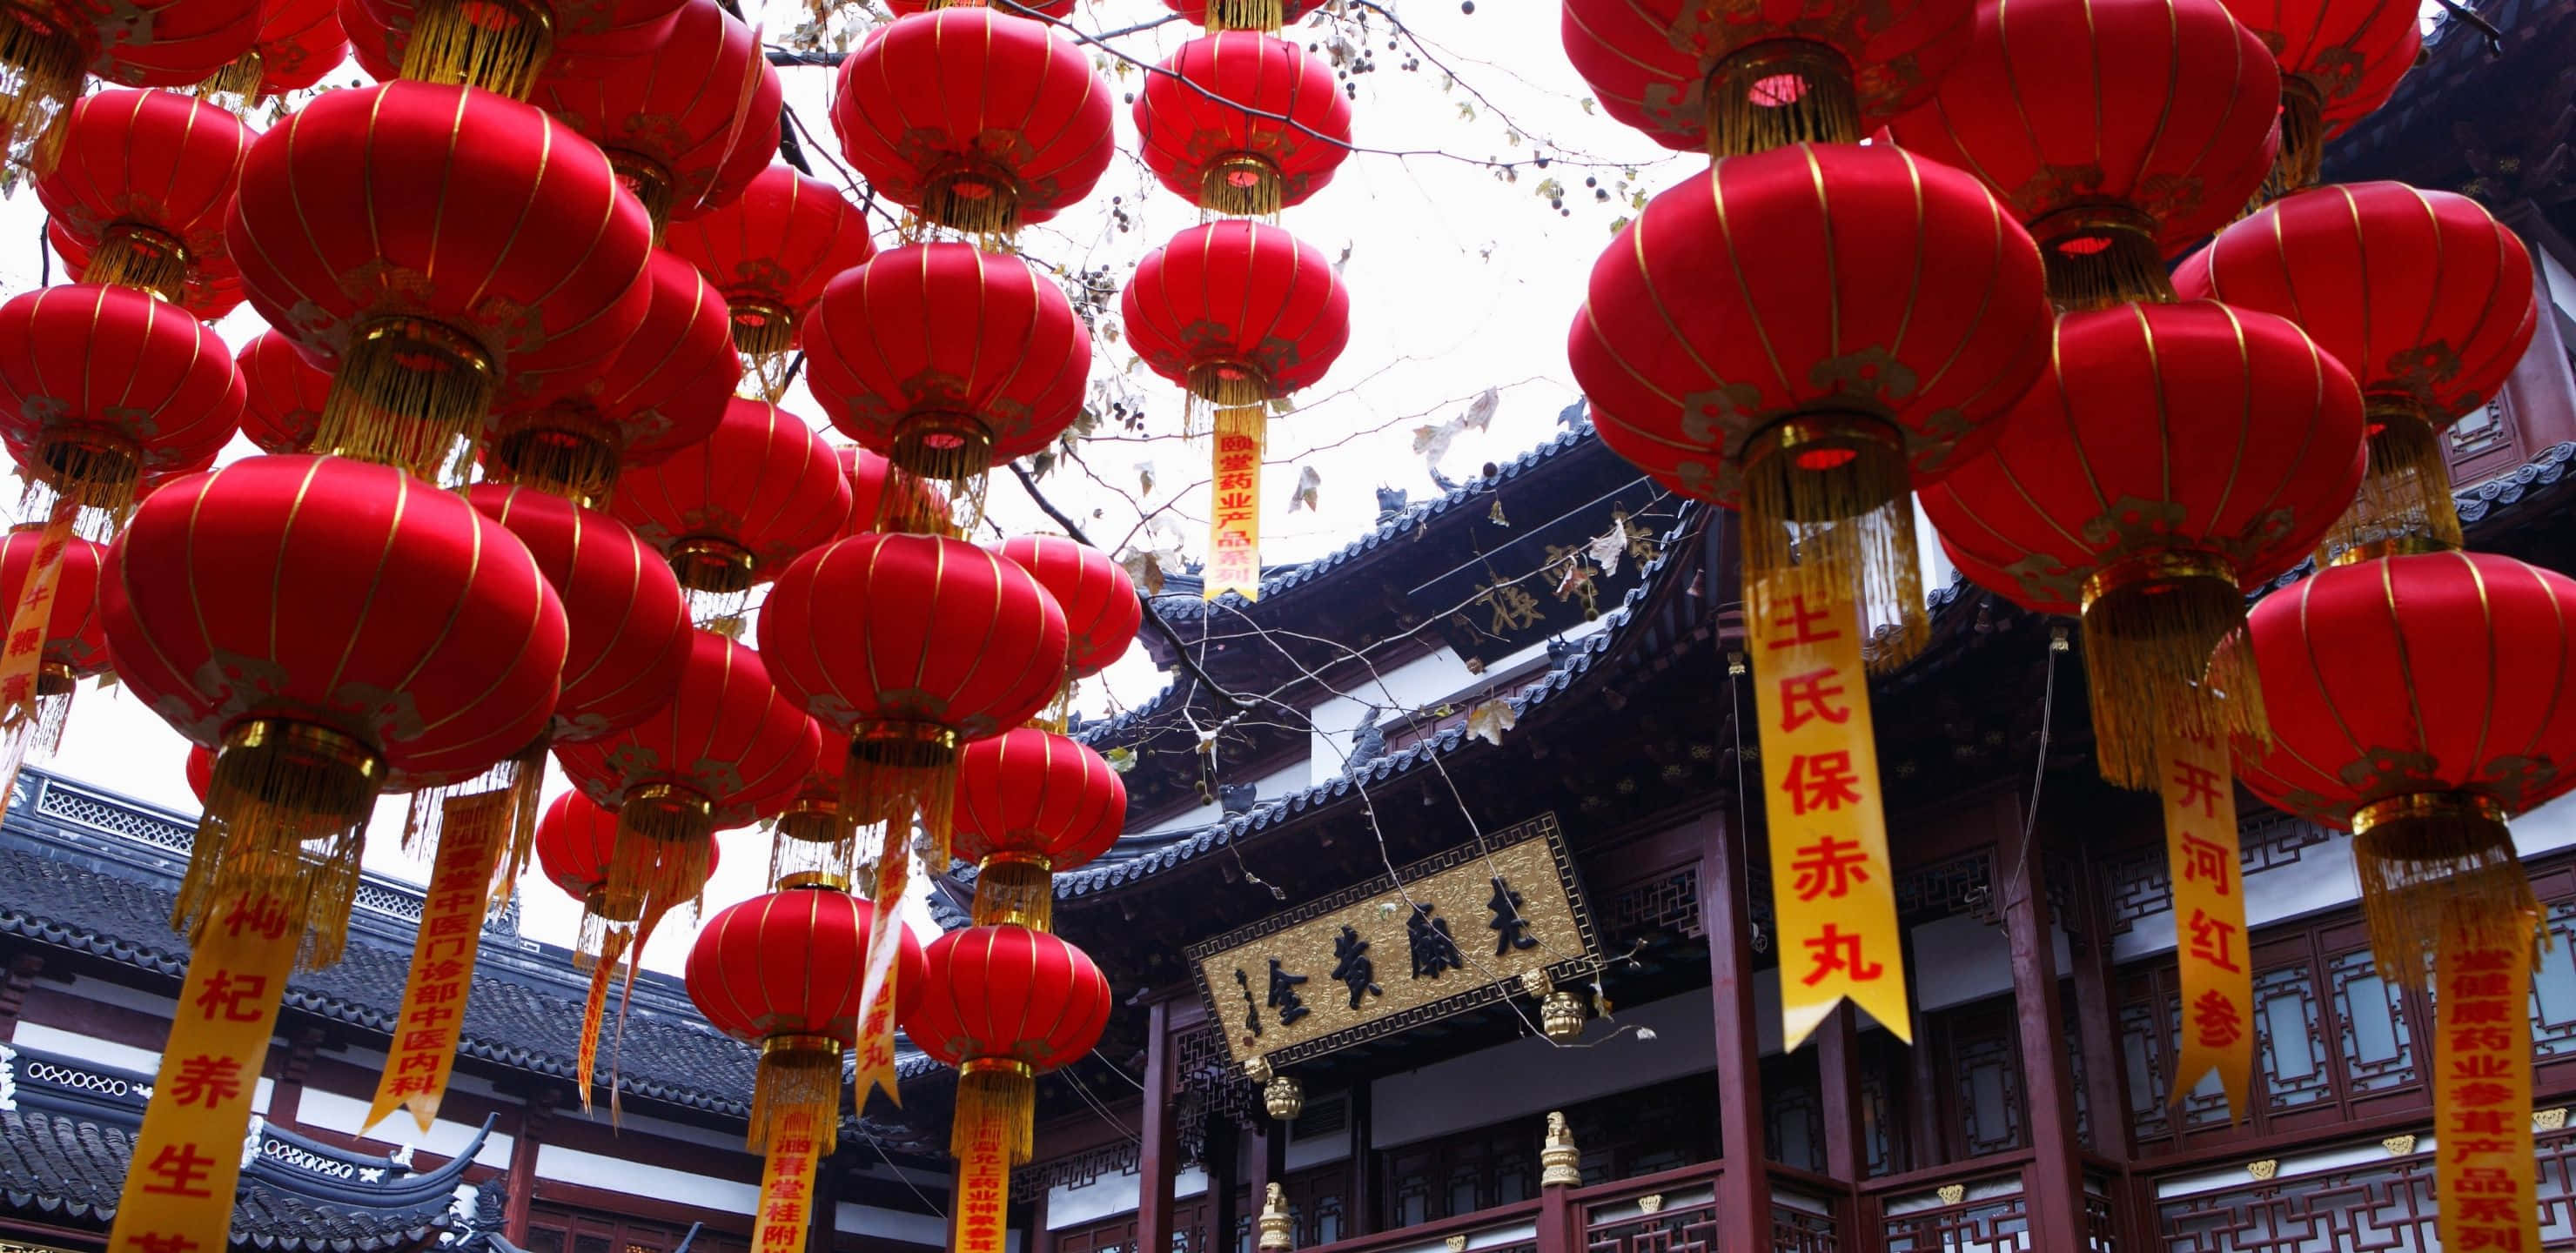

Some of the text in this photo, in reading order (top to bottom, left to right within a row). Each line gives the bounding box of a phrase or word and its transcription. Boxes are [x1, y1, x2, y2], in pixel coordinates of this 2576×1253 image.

[761, 1113, 812, 1253] 涵春堂桂附
[2449, 926, 2521, 1253] 堂健康药业参茸产品系列
